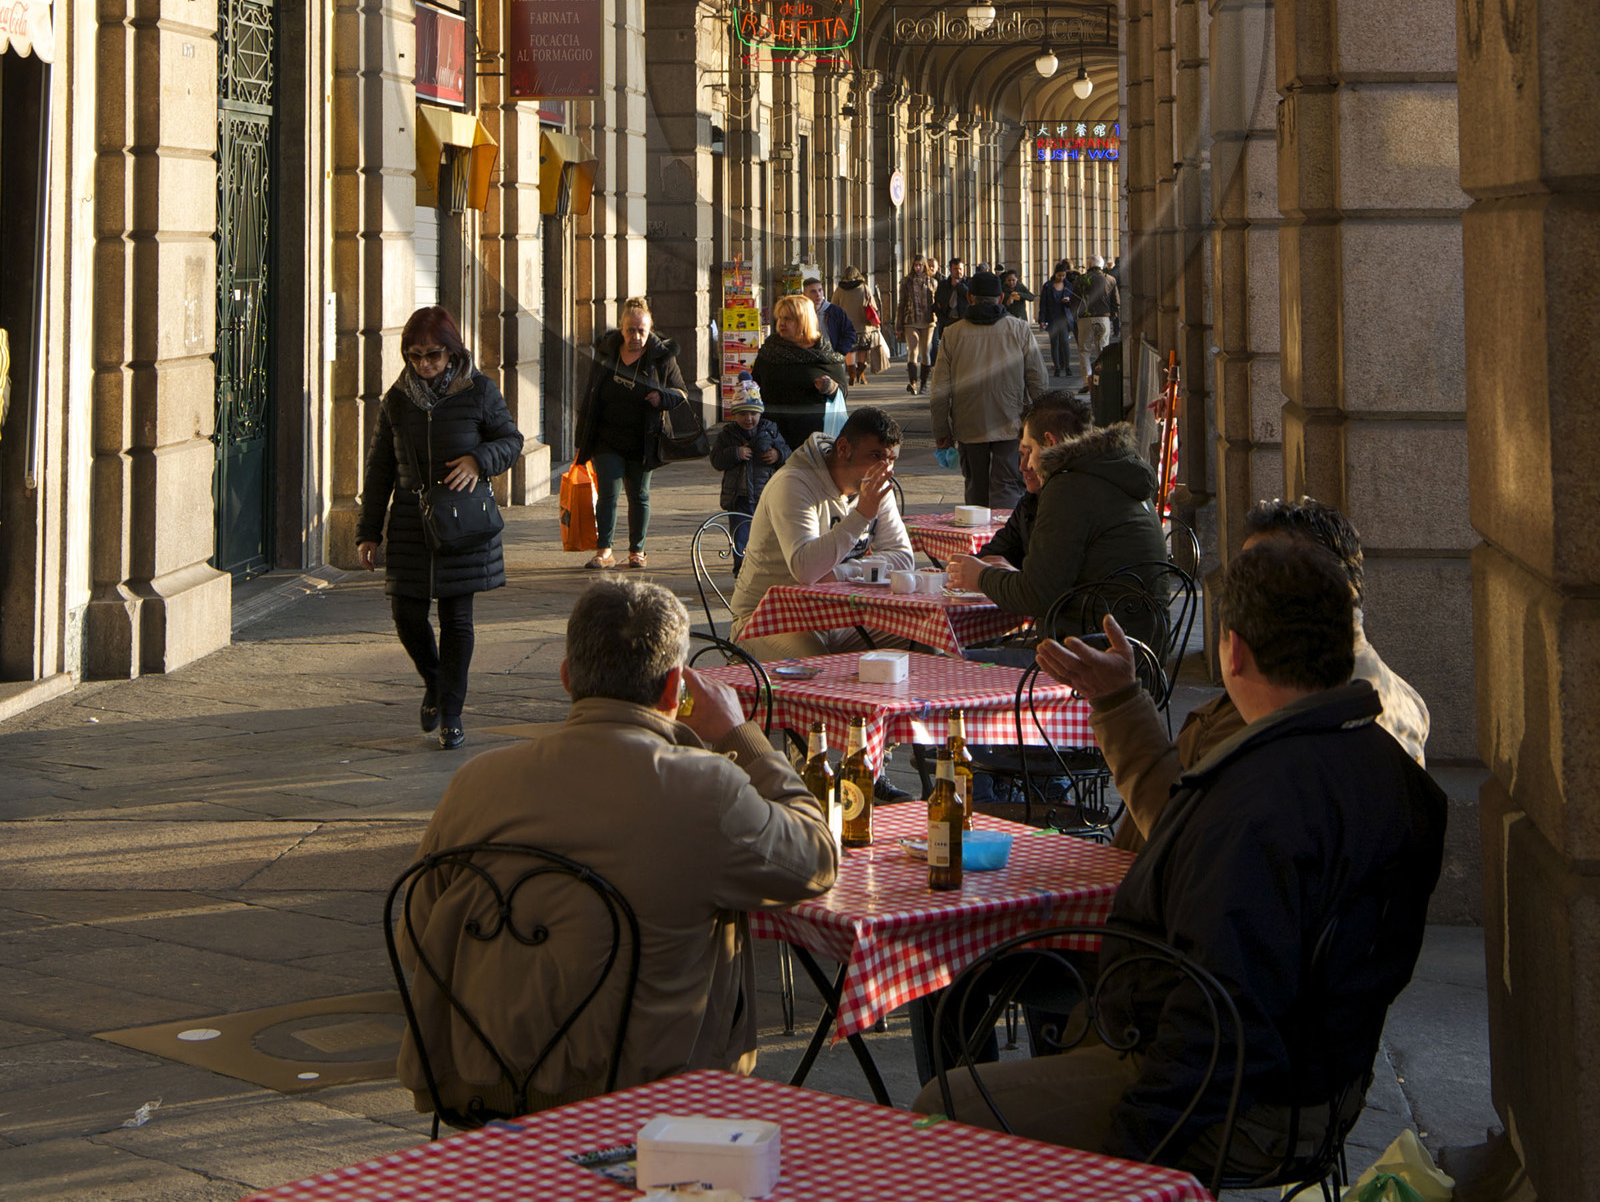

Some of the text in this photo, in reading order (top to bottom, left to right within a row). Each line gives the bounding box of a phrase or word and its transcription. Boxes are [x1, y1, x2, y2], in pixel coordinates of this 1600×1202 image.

[779, 2, 813, 16] della
[529, 11, 580, 24] FARINATA
[896, 9, 1045, 42] colorado
[529, 34, 580, 47] FOCACCIA
[517, 48, 593, 62] AL FORMAGGIO
[1037, 138, 1120, 149] RISTORANT
[1037, 149, 1119, 160] SUSHI WO
